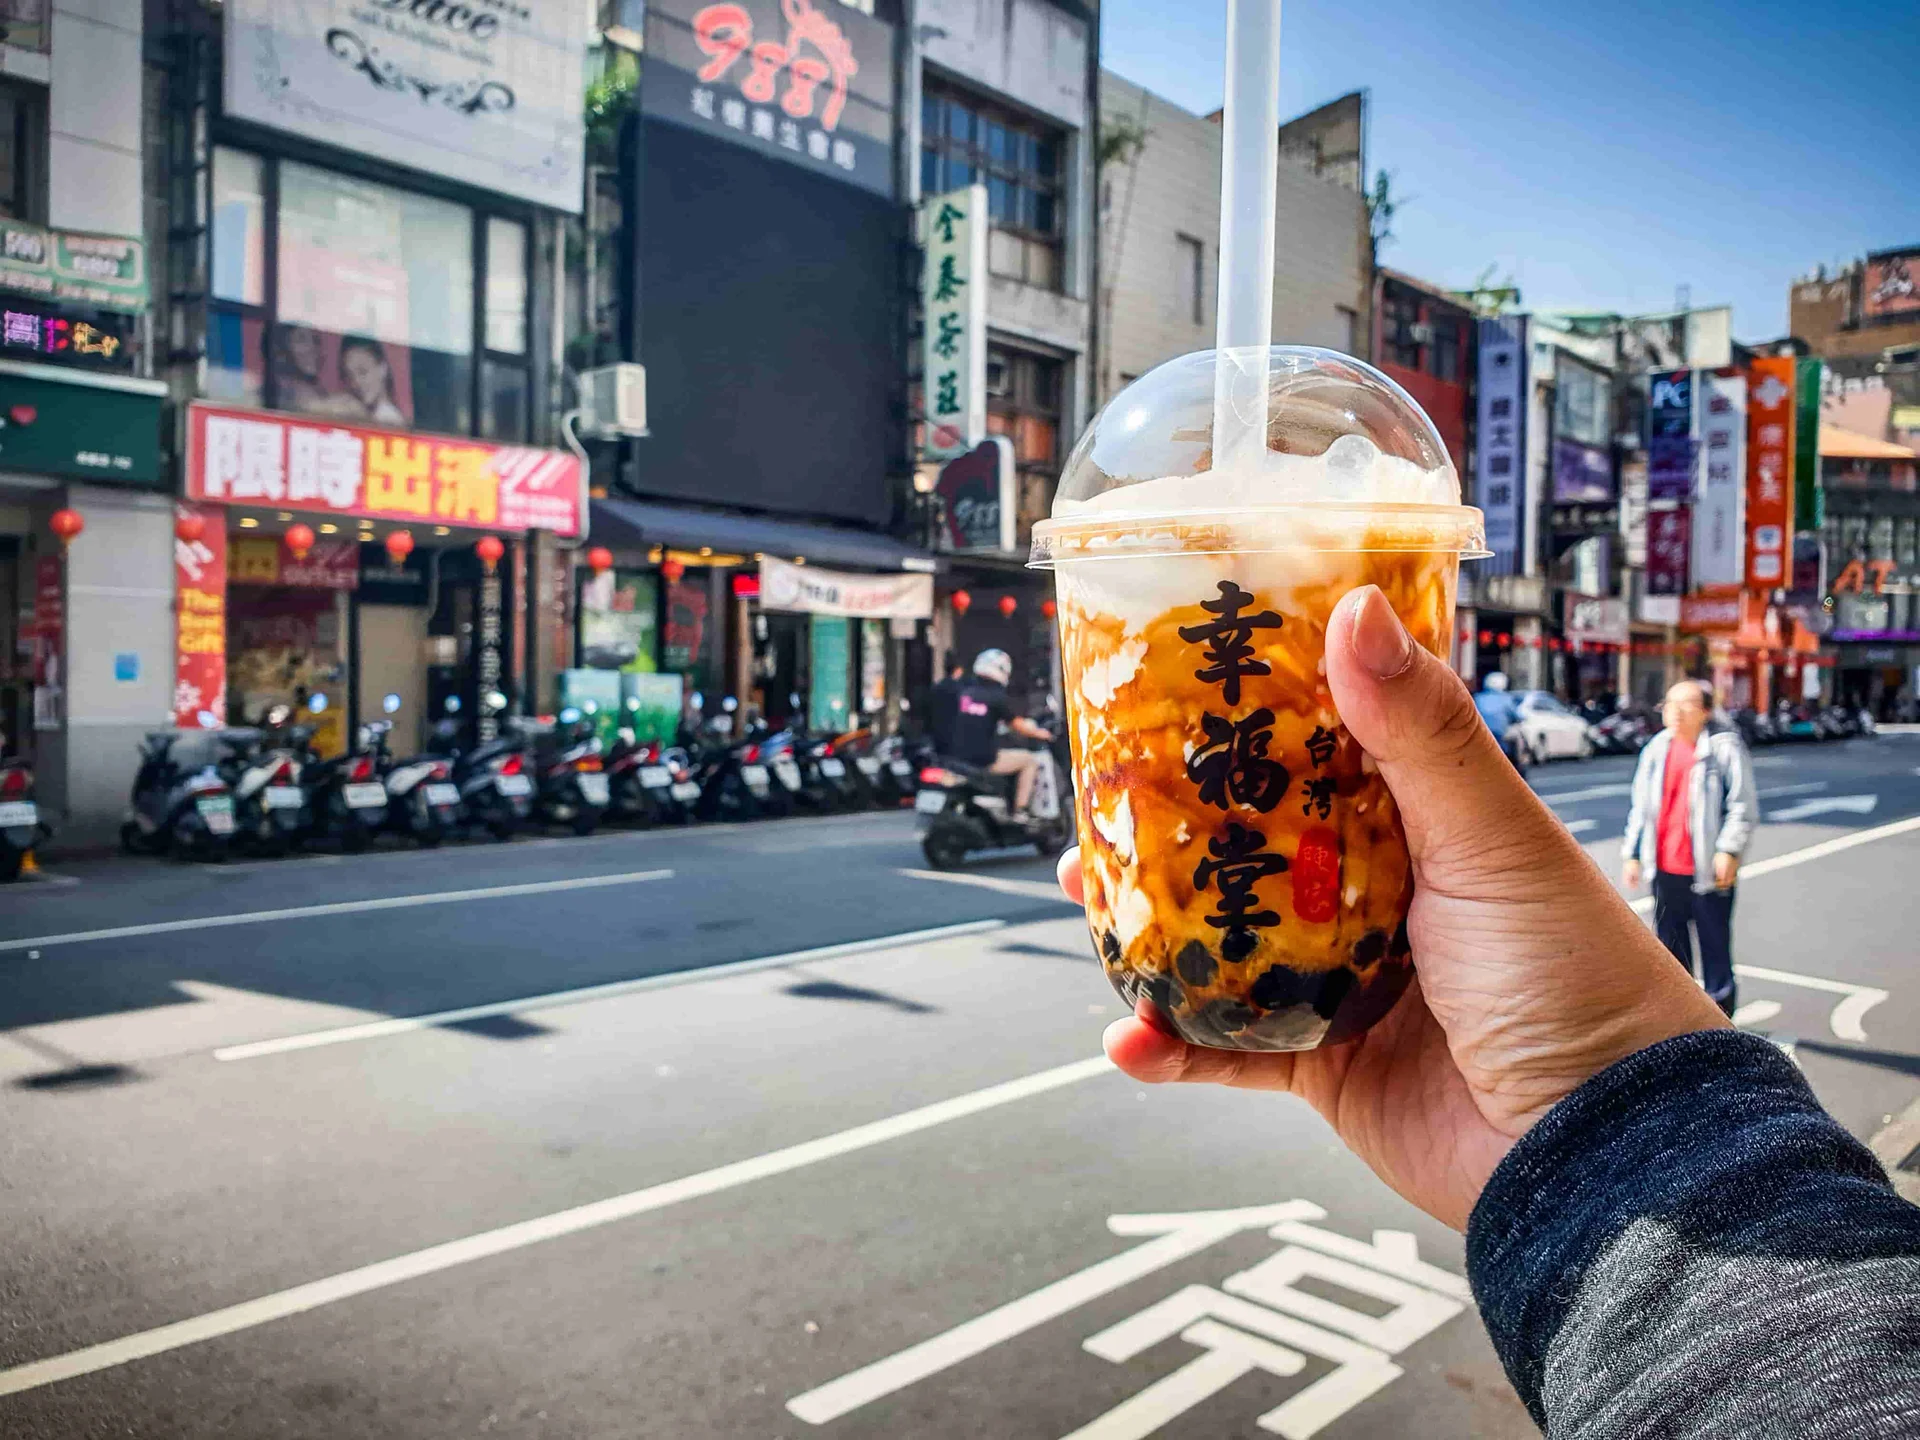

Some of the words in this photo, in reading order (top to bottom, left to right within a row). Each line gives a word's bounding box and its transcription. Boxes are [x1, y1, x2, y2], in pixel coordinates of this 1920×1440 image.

[205, 415, 499, 523] 限時出清
[1178, 580, 1289, 929] 幸福堂
